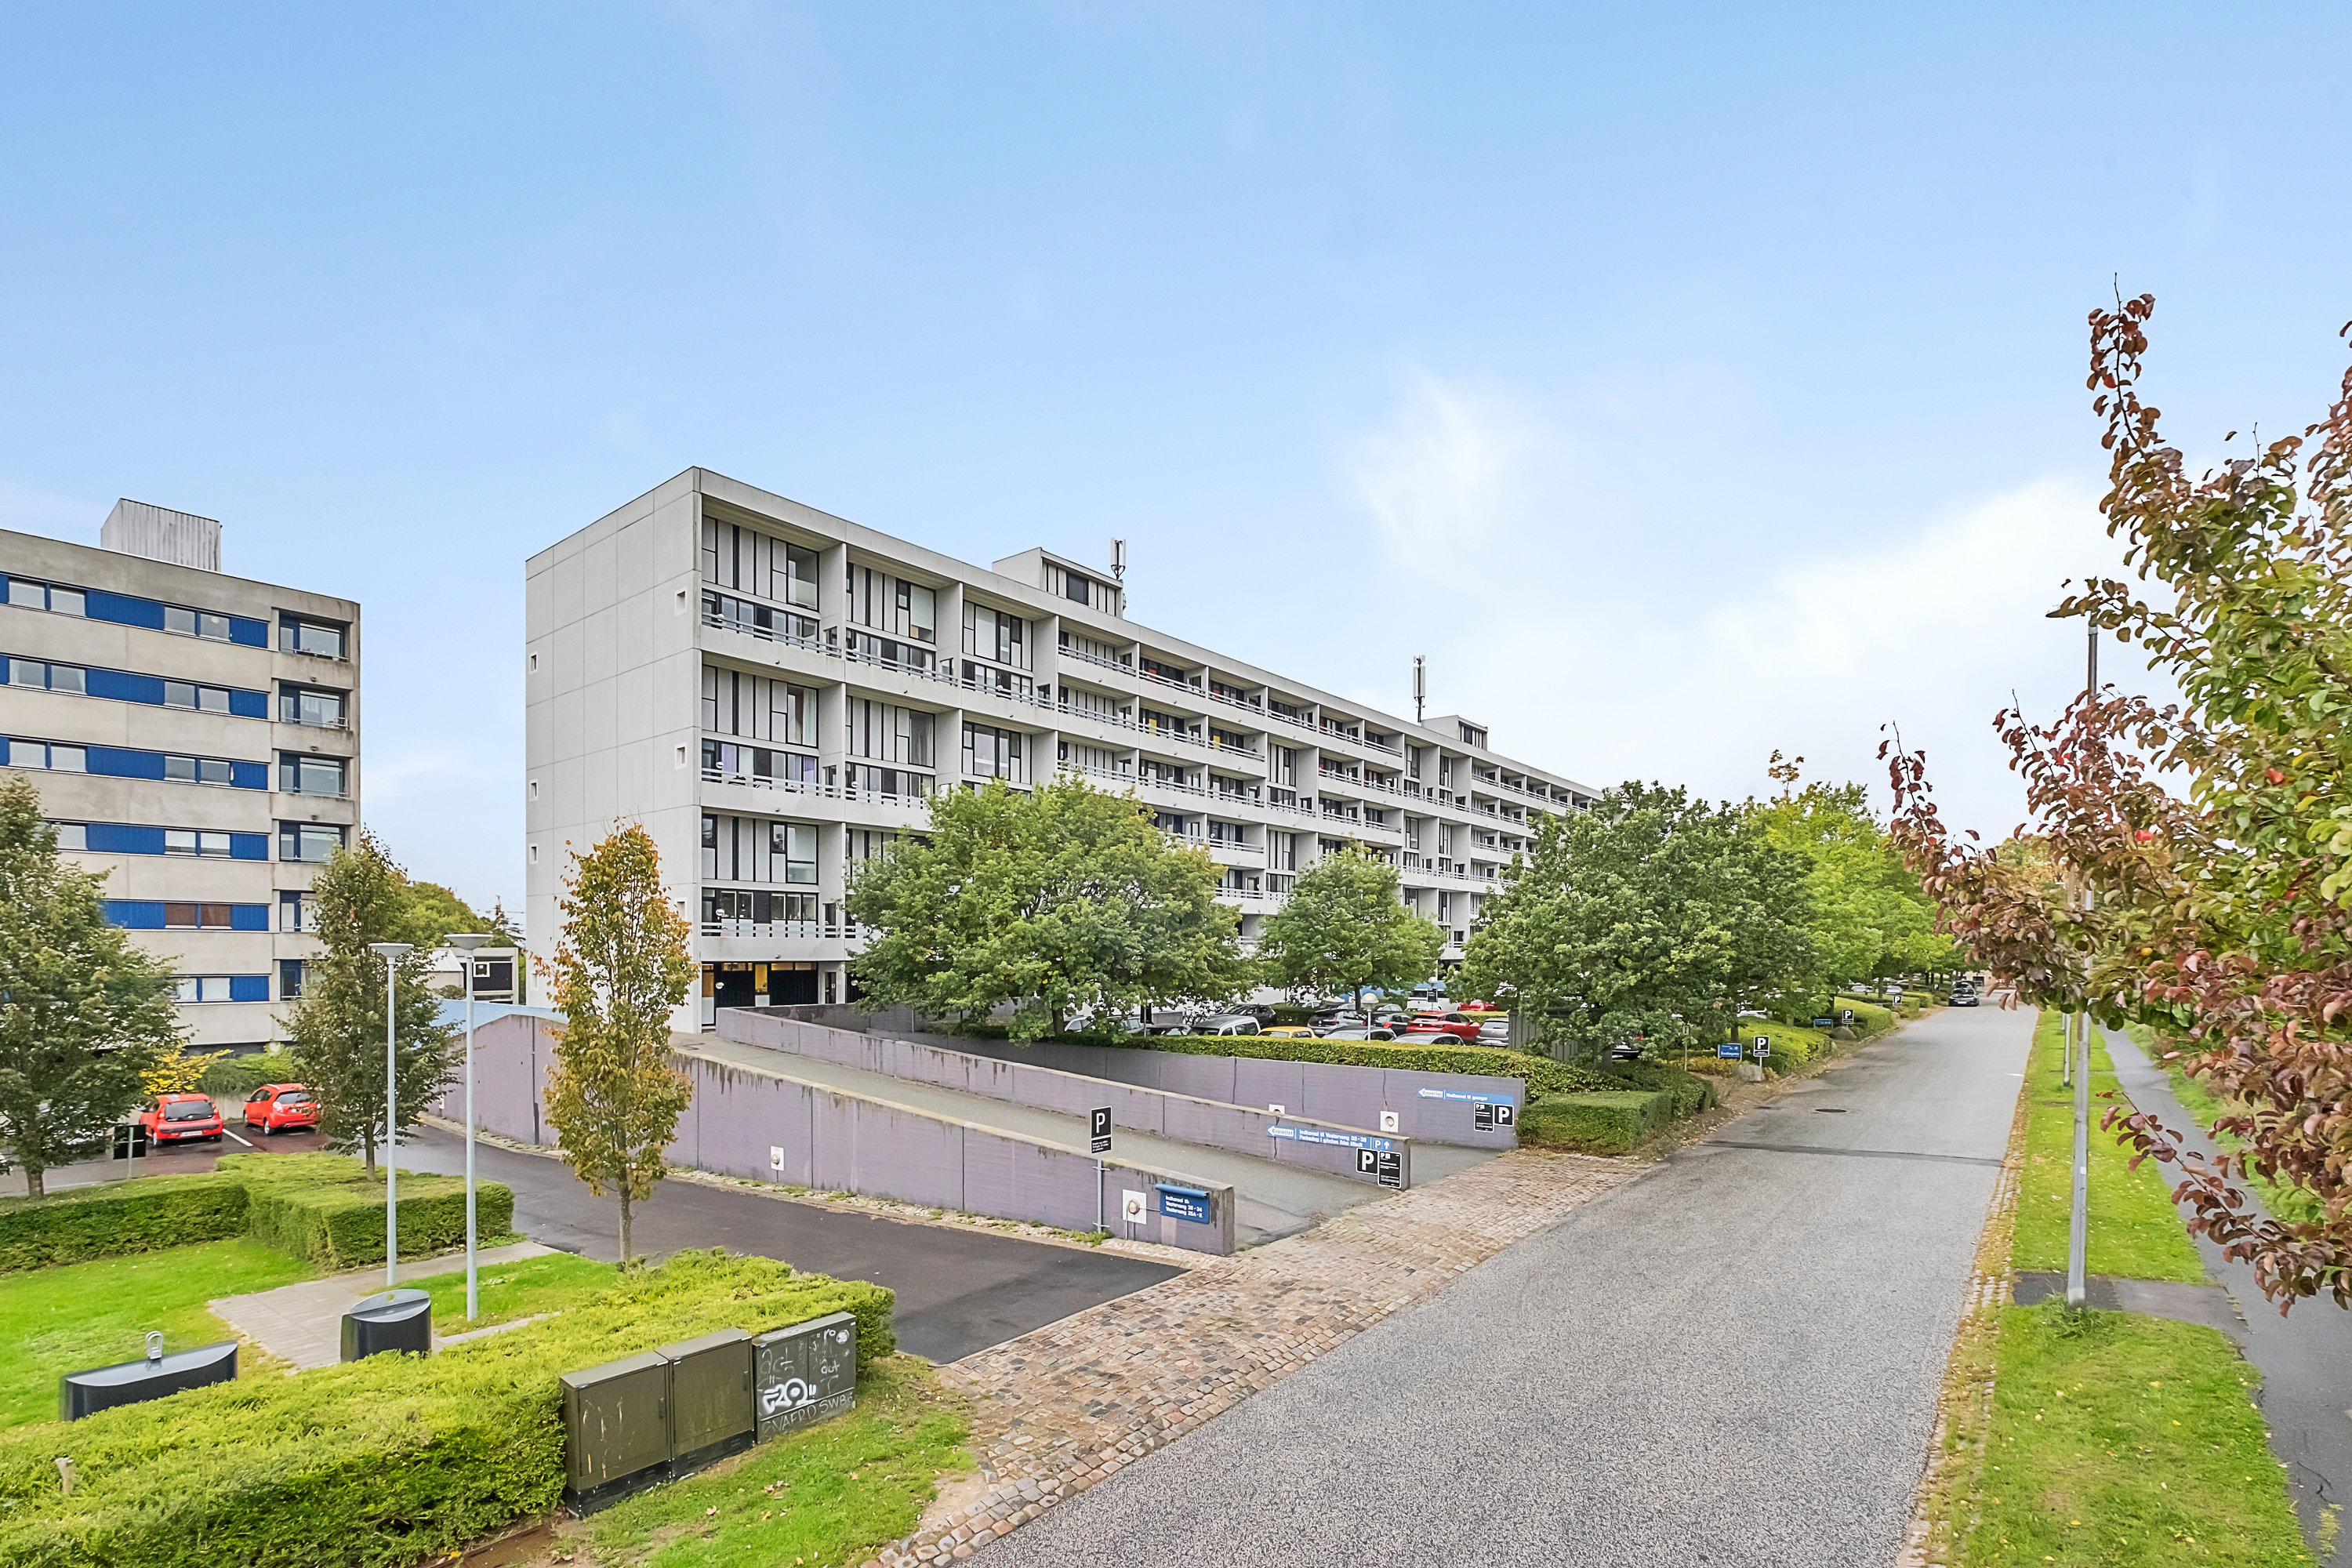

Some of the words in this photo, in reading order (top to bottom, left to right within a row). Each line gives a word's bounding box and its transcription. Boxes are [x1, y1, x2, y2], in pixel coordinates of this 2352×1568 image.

[1845, 1011, 1851, 1019] P
[1757, 1037, 1766, 1050] P
[1498, 1106, 1510, 1123] P
[1096, 1112, 1105, 1133] P
[1374, 1140, 1381, 1149] P
[1361, 1151, 1374, 1171] P
